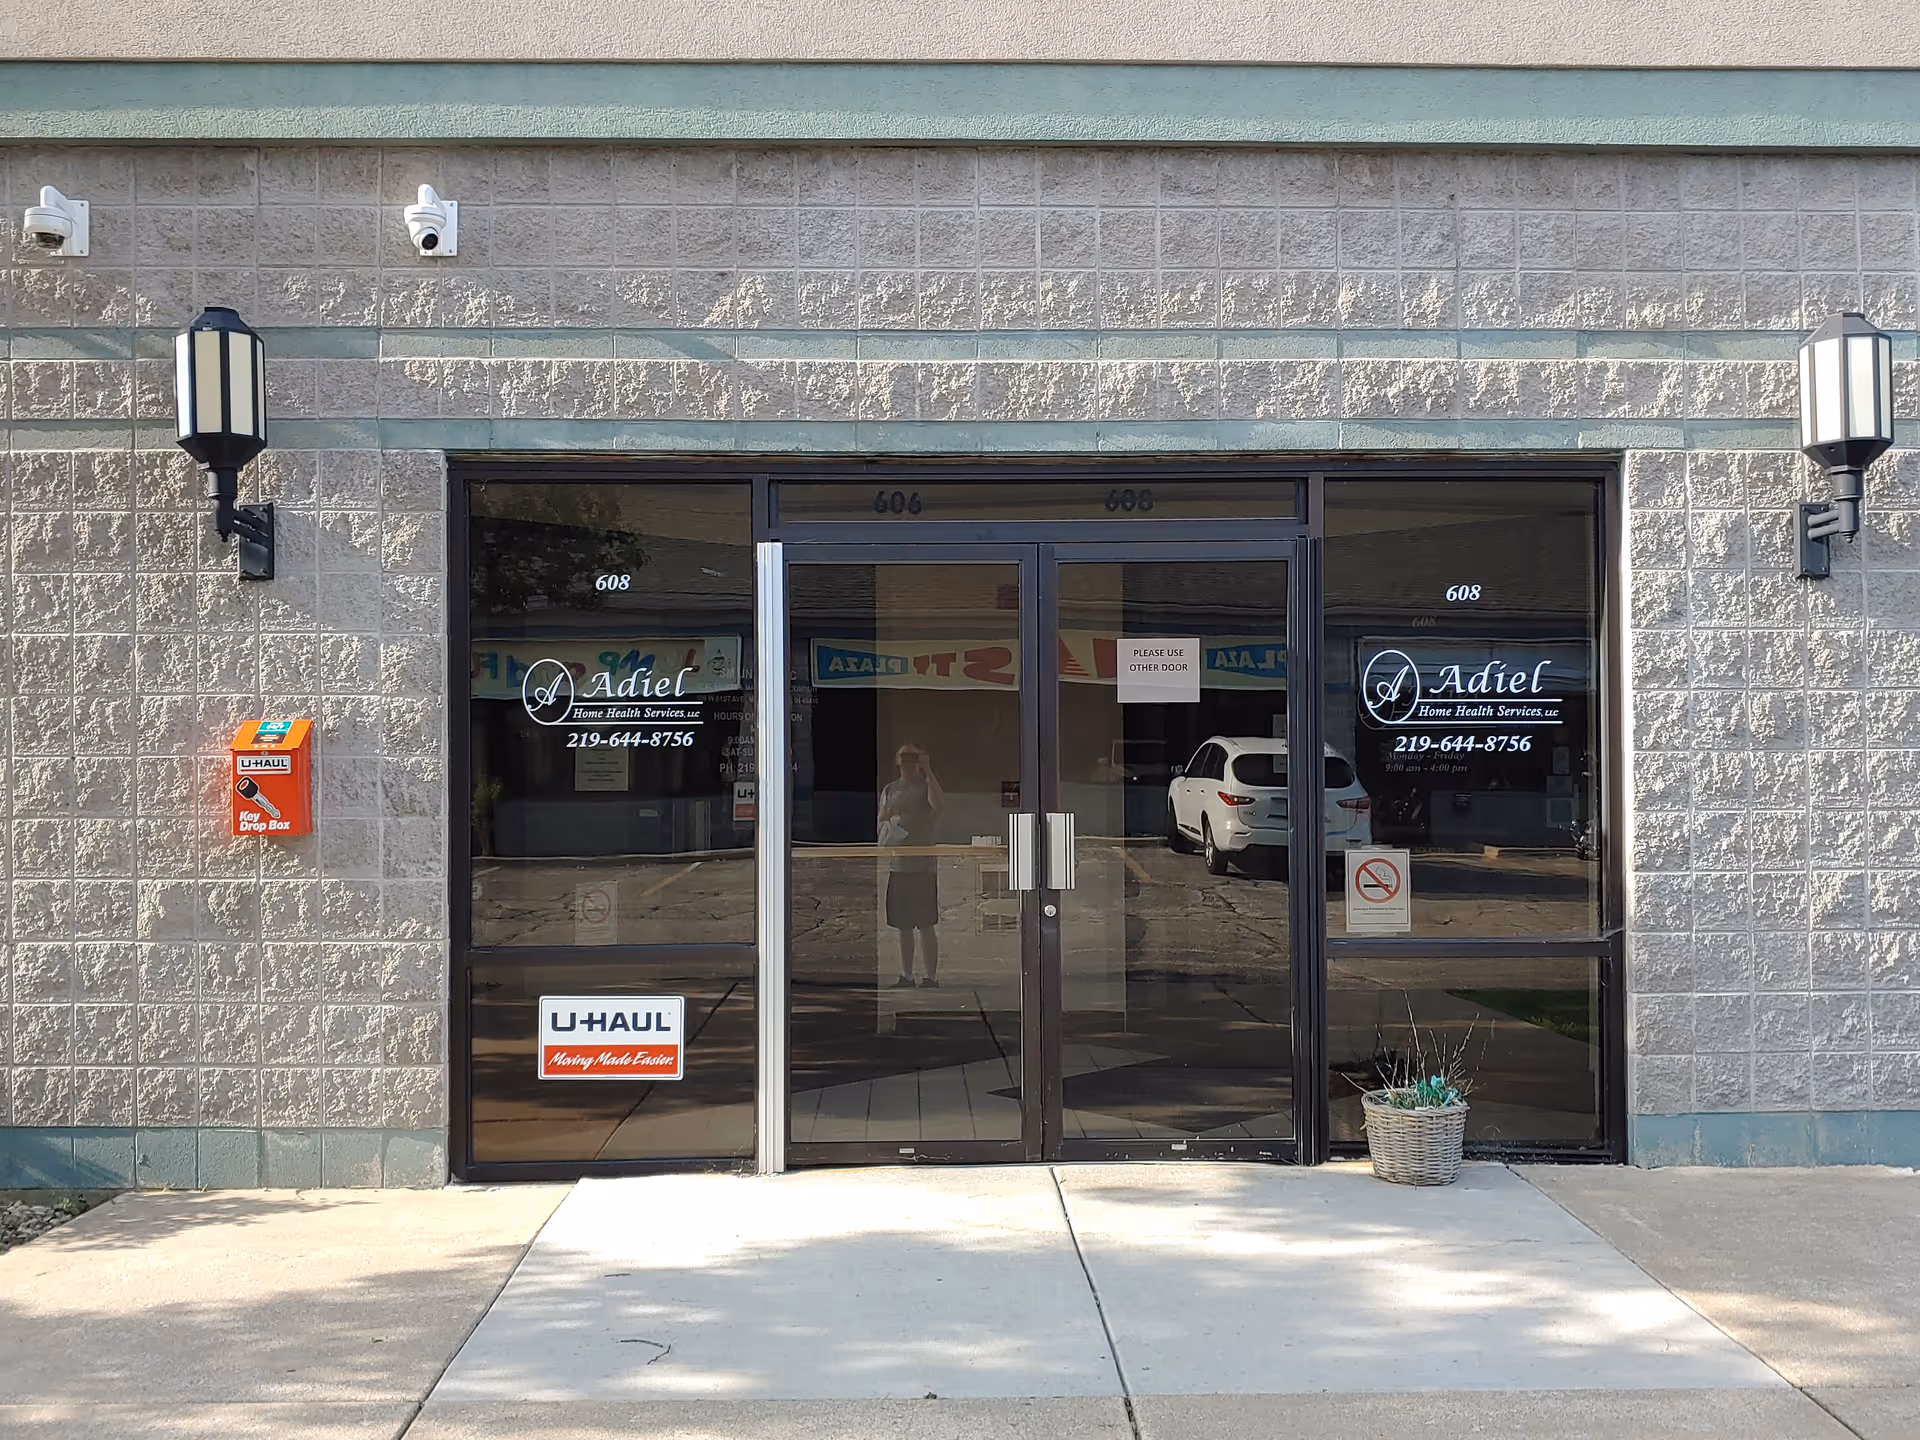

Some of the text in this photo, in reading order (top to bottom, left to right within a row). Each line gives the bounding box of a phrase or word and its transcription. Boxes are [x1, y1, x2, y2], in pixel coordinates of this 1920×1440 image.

[1105, 488, 1154, 513] 608
[595, 574, 631, 591] 608
[1446, 584, 1481, 601] 608
[1133, 649, 1184, 657] PLEASE USE
[1129, 663, 1188, 672] OTHER DOOR
[582, 667, 694, 698] Adiel
[1429, 660, 1552, 694] Adiel
[572, 708, 604, 719] Home
[606, 707, 641, 719] Health
[714, 712, 743, 721] HOURS
[1418, 705, 1451, 717] Home
[1455, 705, 1494, 717] Health
[566, 732, 694, 748] 219-644-8756
[1394, 735, 1532, 752] 219-644-8756
[241, 759, 288, 768] U-HAUL
[1387, 751, 1424, 762] Monday
[1433, 751, 1465, 762] Friday
[239, 811, 261, 823] Key
[240, 820, 290, 832] Drop Box
[551, 1011, 671, 1032] U-HAUL
[548, 1051, 595, 1071] Moving
[594, 1051, 633, 1066] Made
